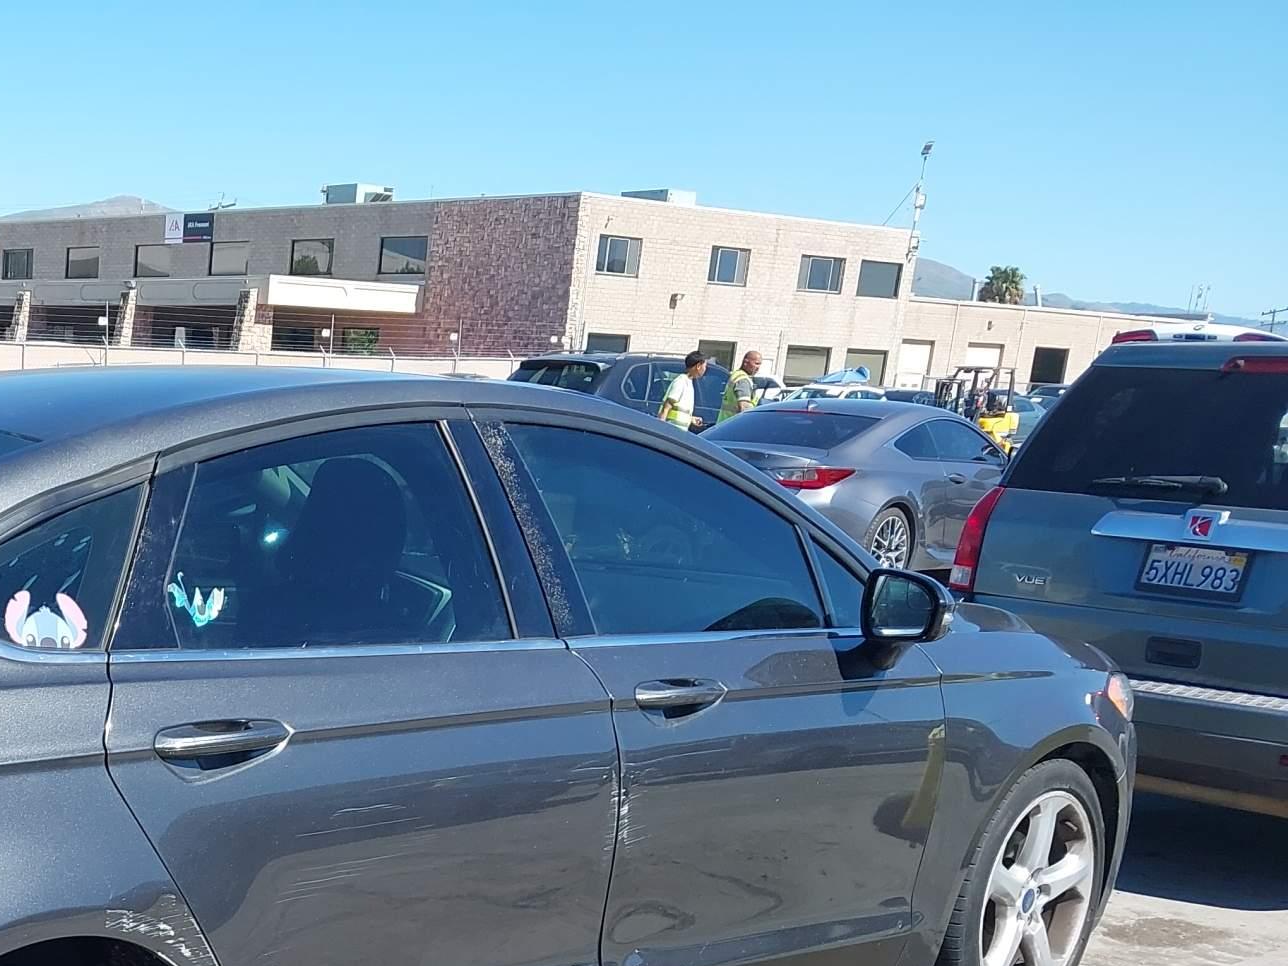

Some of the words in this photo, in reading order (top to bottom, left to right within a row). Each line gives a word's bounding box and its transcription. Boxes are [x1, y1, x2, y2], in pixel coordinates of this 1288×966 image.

[1167, 547, 1229, 561] California
[1015, 575, 1045, 585] VUE
[1146, 560, 1240, 591] 5XHL983
